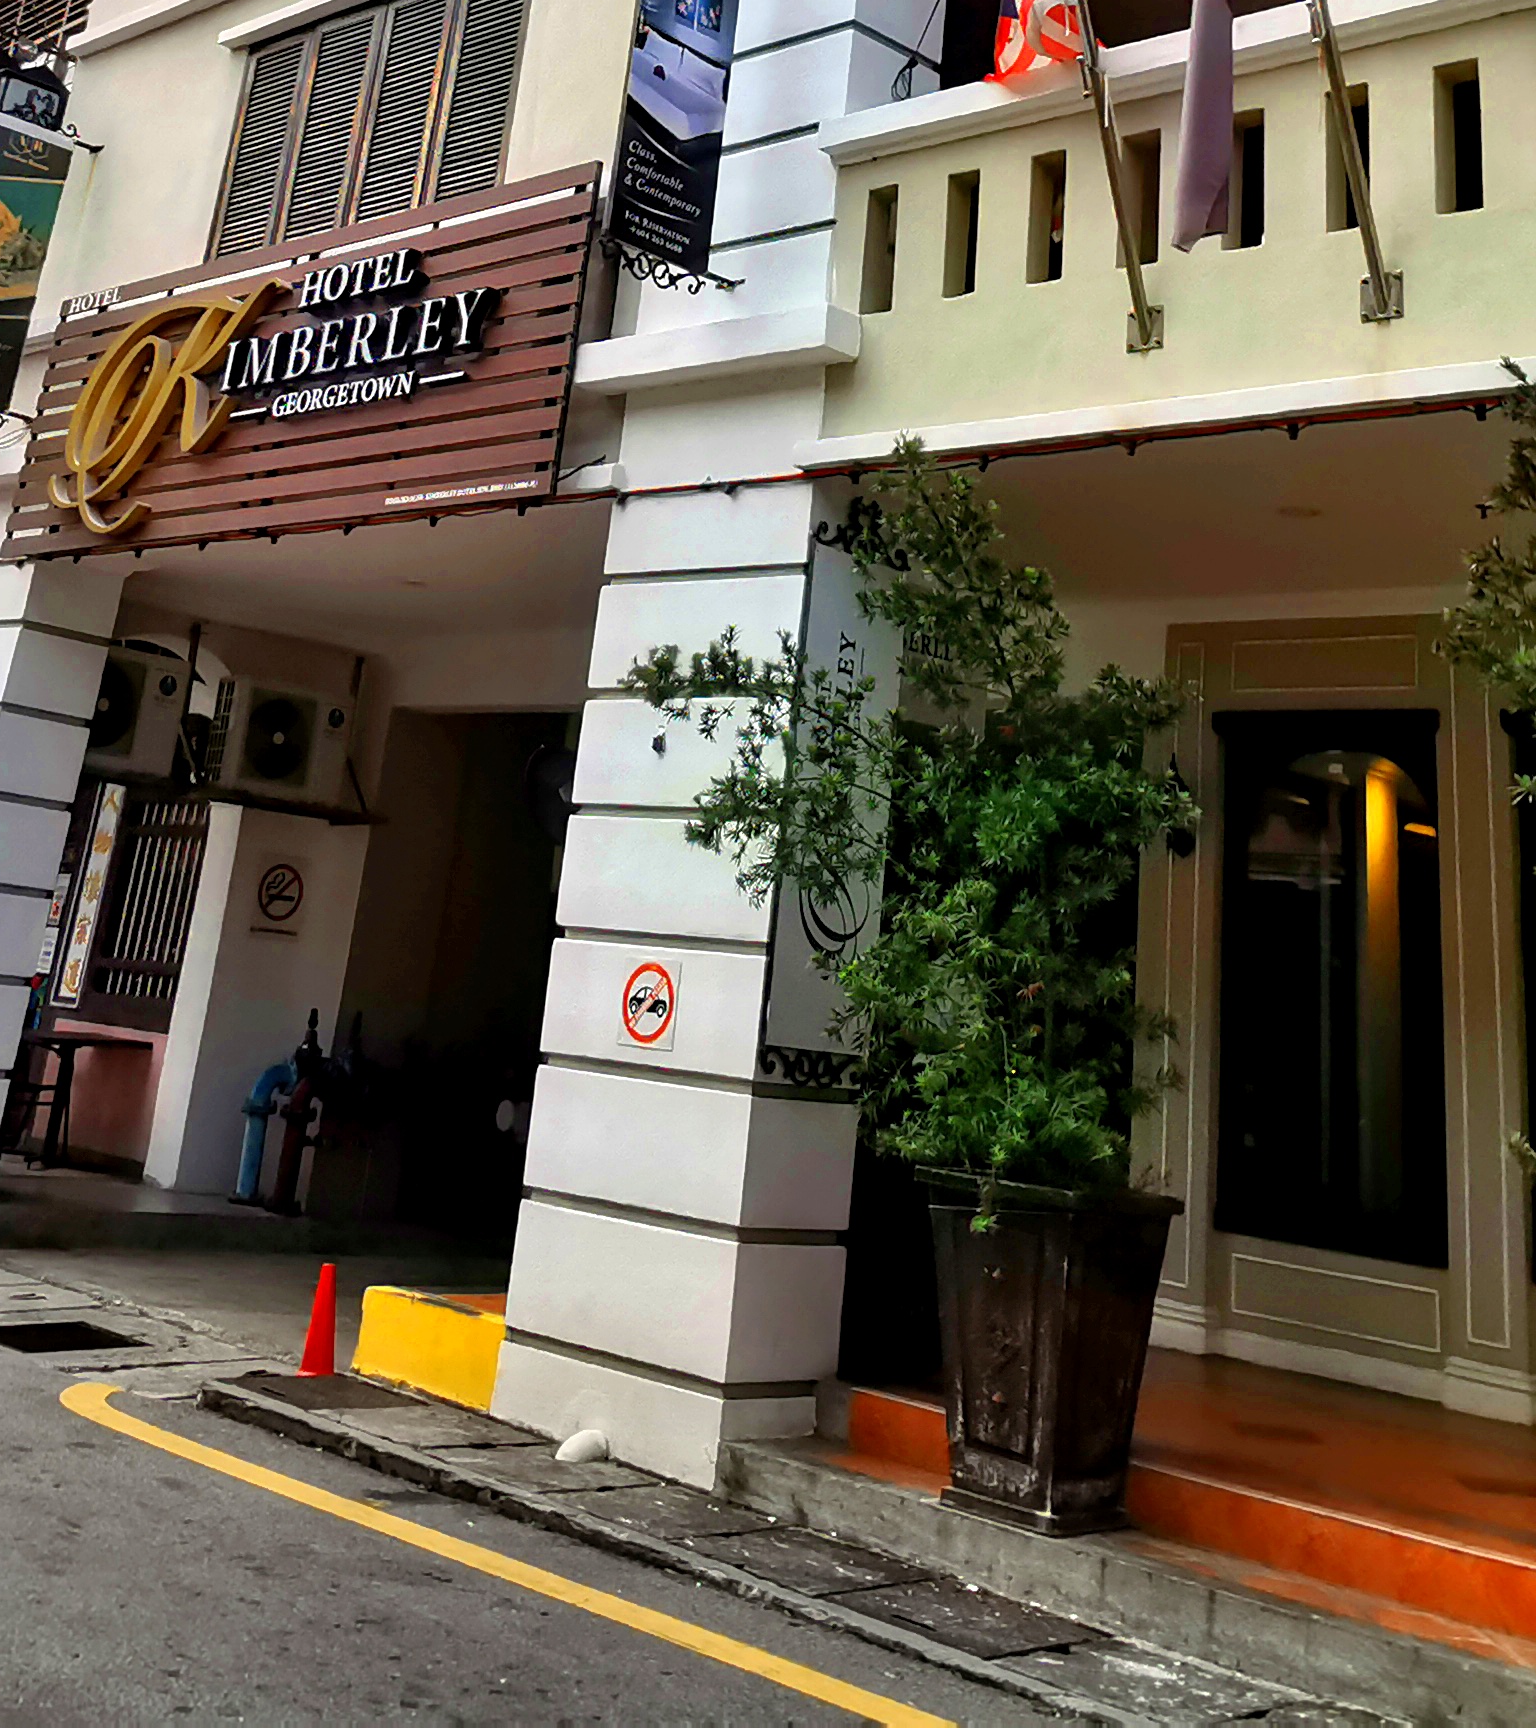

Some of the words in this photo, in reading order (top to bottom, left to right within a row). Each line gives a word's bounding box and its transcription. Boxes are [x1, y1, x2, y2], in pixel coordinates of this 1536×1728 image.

[624, 173, 633, 186] &
[635, 178, 702, 218] Contemporary
[626, 156, 684, 192] Comfortable
[68, 286, 122, 314] HOTEL
[298, 248, 418, 309] HOTEL
[272, 370, 416, 418] GEORGETOWN
